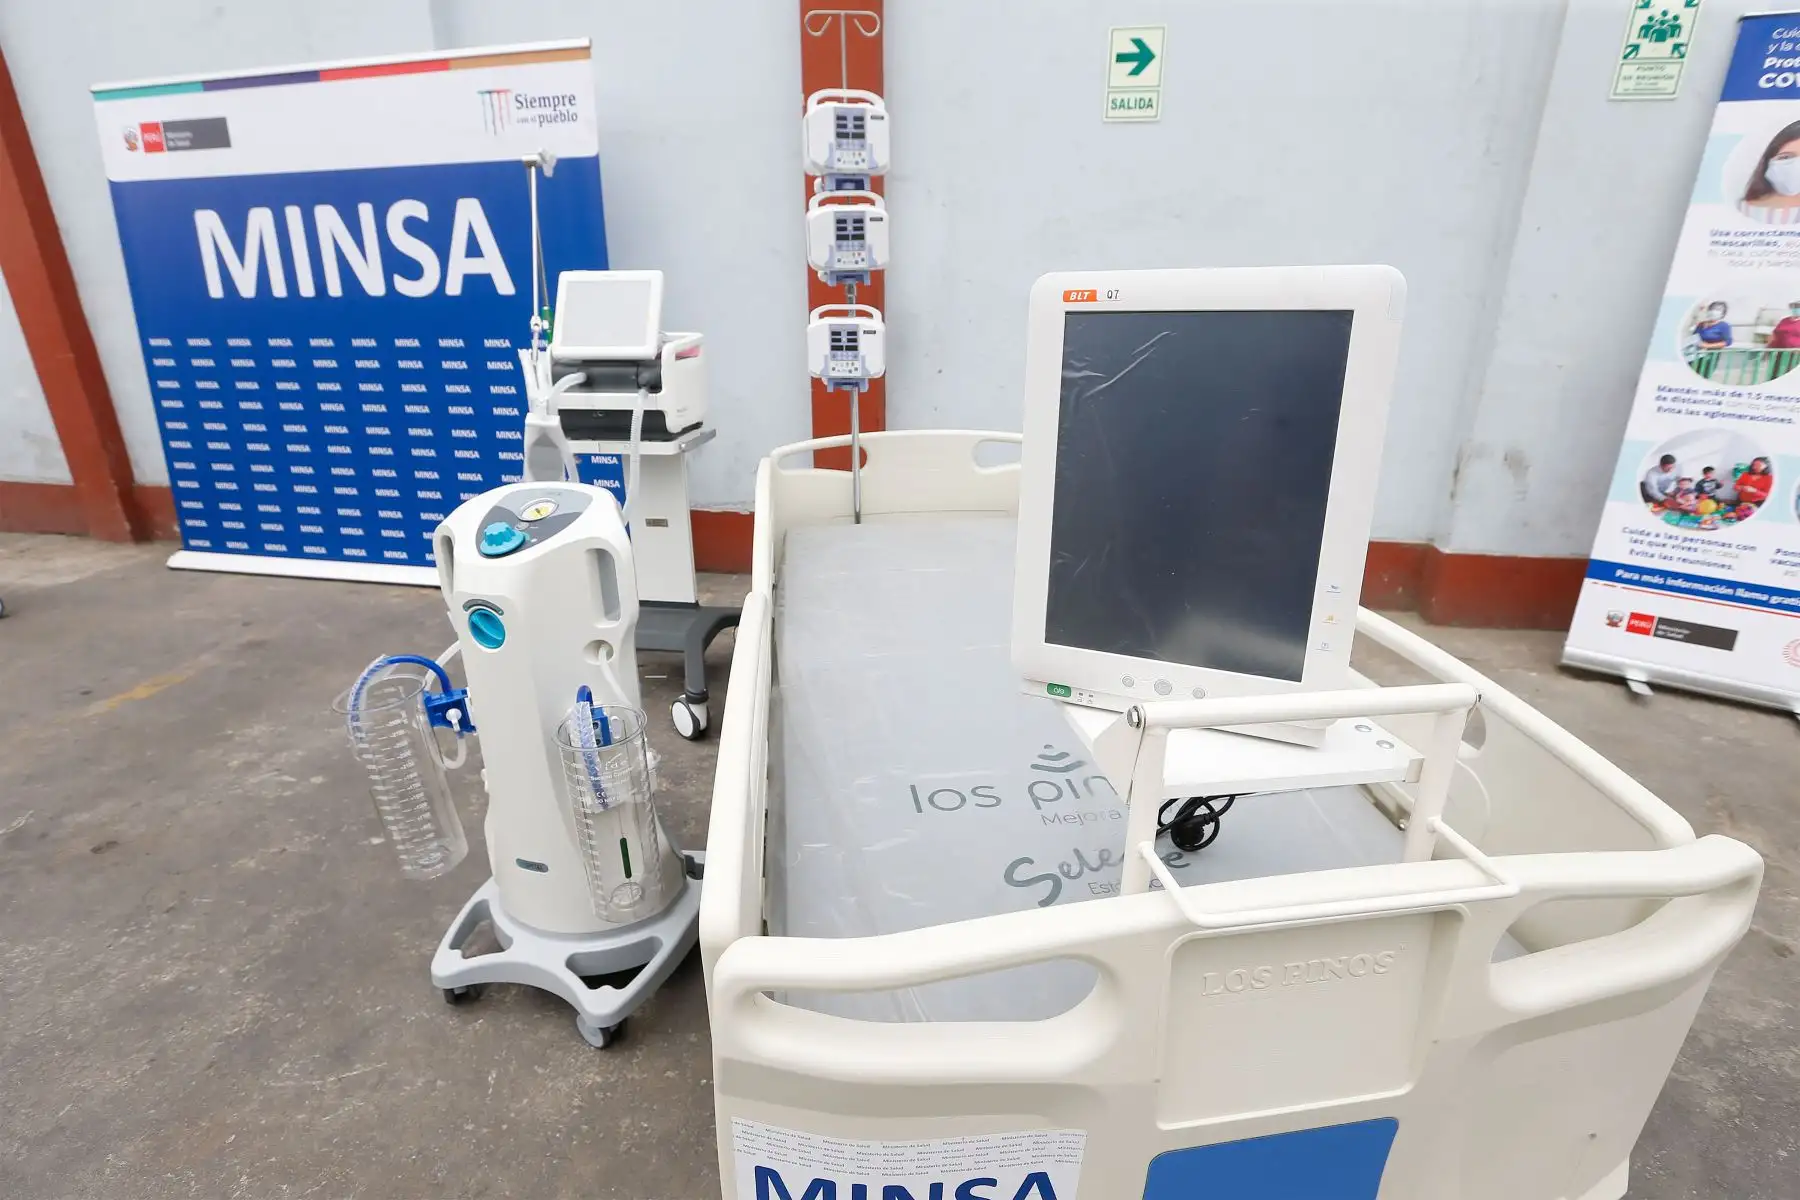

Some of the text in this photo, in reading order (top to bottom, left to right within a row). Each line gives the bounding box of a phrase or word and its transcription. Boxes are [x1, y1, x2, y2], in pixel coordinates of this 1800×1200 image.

[514, 93, 577, 112] Siempre
[1110, 97, 1153, 110] SALIDA
[538, 110, 578, 128] pueblo
[194, 197, 516, 300] MINSA
[1069, 291, 1091, 300] BLT
[438, 339, 465, 348] MINSA
[483, 339, 512, 348] MINSA
[441, 361, 468, 370] MINSA
[486, 362, 514, 371] MINSA
[401, 384, 427, 393] MINSA
[444, 385, 472, 394] MINSA
[489, 386, 517, 395] MINSA
[404, 405, 430, 414] MINSA
[447, 406, 474, 415] MINSA
[492, 408, 520, 416] MINSA
[407, 428, 434, 437] MINSA
[451, 430, 477, 438] MINSA
[495, 431, 522, 439] MINSA
[410, 449, 437, 457] MINSA
[454, 450, 480, 459] MINSA
[498, 452, 524, 460] MINSA
[590, 456, 618, 464] MINSA
[414, 471, 440, 480] MINSA
[457, 473, 483, 482] MINSA
[501, 475, 524, 483] MINS
[593, 479, 620, 487] MINSA
[417, 491, 442, 500] MINSA
[419, 512, 445, 520] MINSA
[1629, 537, 1644, 545] las
[1647, 540, 1666, 549] que
[1671, 542, 1698, 553] vives
[1663, 532, 1679, 541] las
[1682, 535, 1733, 549] personas
[1735, 543, 1757, 551] con
[1629, 549, 1655, 558] Evita
[1658, 552, 1673, 561] las
[1615, 569, 1640, 581] Para
[1641, 573, 1665, 584] más
[1666, 577, 1734, 595] información
[1734, 587, 1769, 601] llama
[909, 775, 1119, 814] los pin
[1040, 810, 1123, 827] Mejora
[1003, 848, 1192, 908] Selee
[1201, 950, 1395, 996] LOS PINOS
